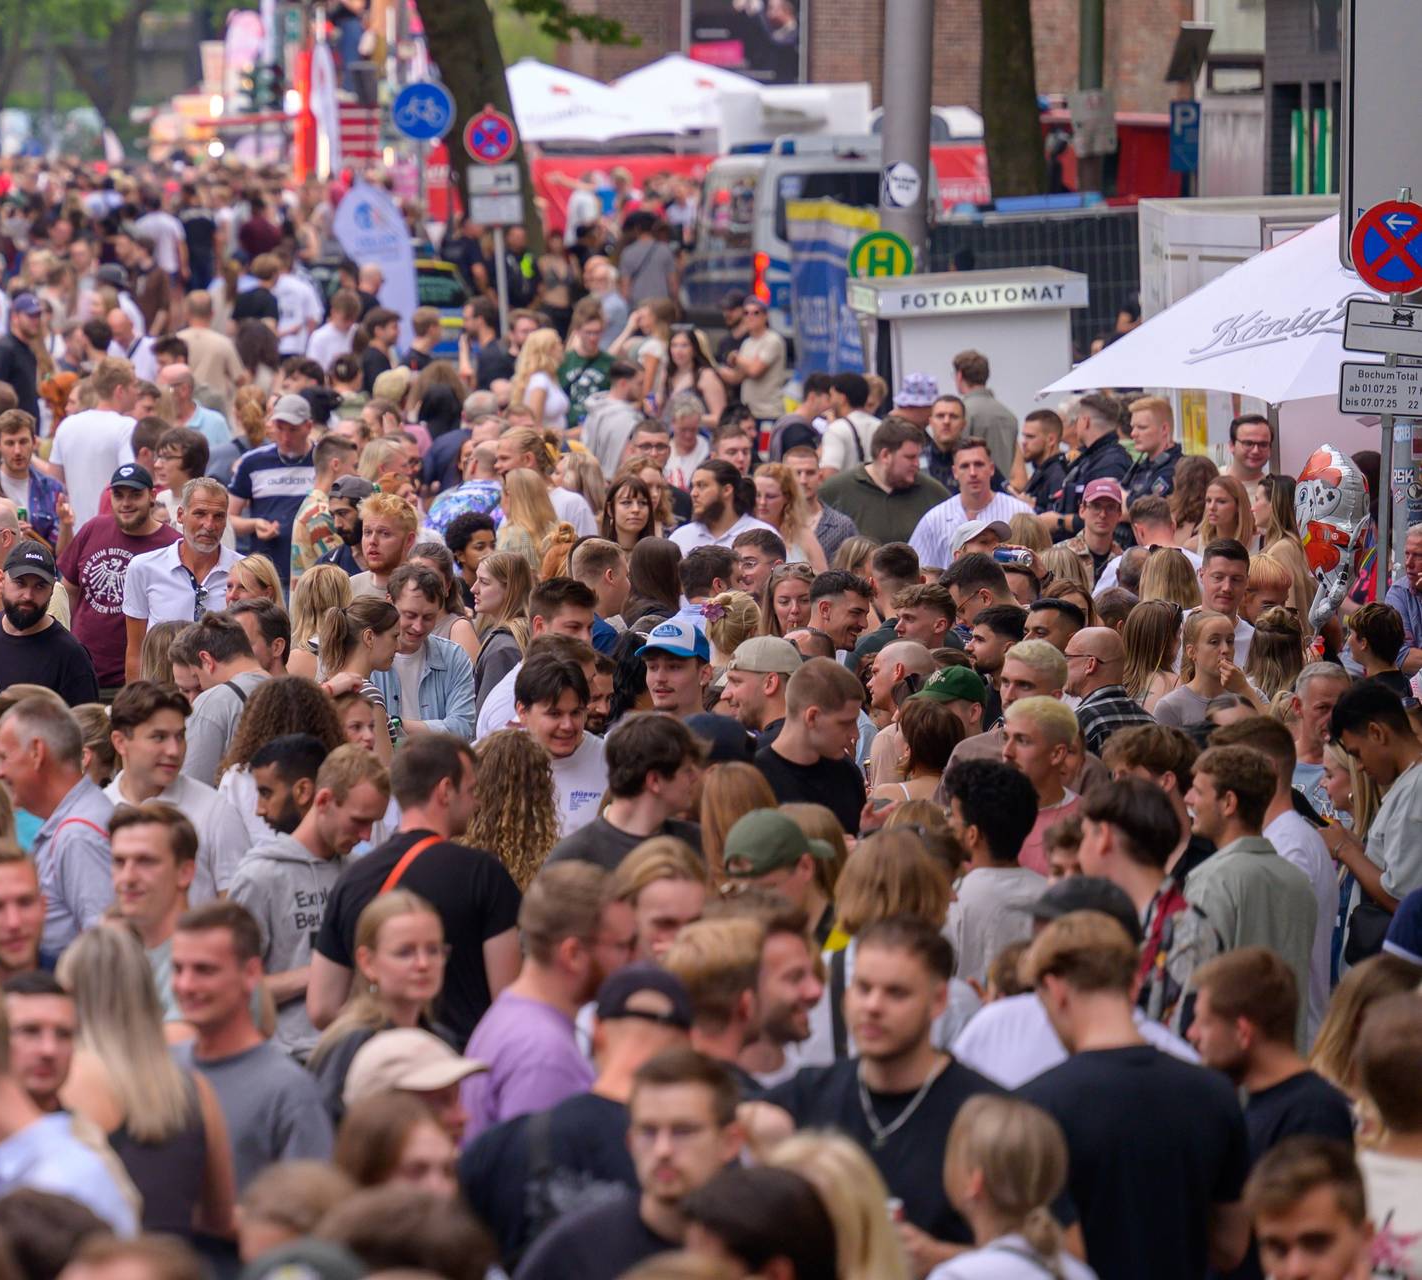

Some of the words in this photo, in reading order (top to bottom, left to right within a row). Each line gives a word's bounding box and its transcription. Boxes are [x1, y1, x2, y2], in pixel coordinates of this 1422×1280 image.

[901, 284, 1065, 309] FOTOAUTOMAT
[1189, 307, 1331, 354] König
[1358, 369, 1394, 380] Bochum
[1396, 371, 1419, 381] Total
[1349, 384, 1360, 393] ab
[1362, 384, 1397, 394] 01.07.25
[1408, 386, 1417, 395] 17
[1345, 397, 1359, 406] bis
[1360, 398, 1398, 408] 07.07.25
[1408, 400, 1419, 409] 22
[90, 549, 107, 562] ZUM
[89, 598, 109, 614] TOTEN
